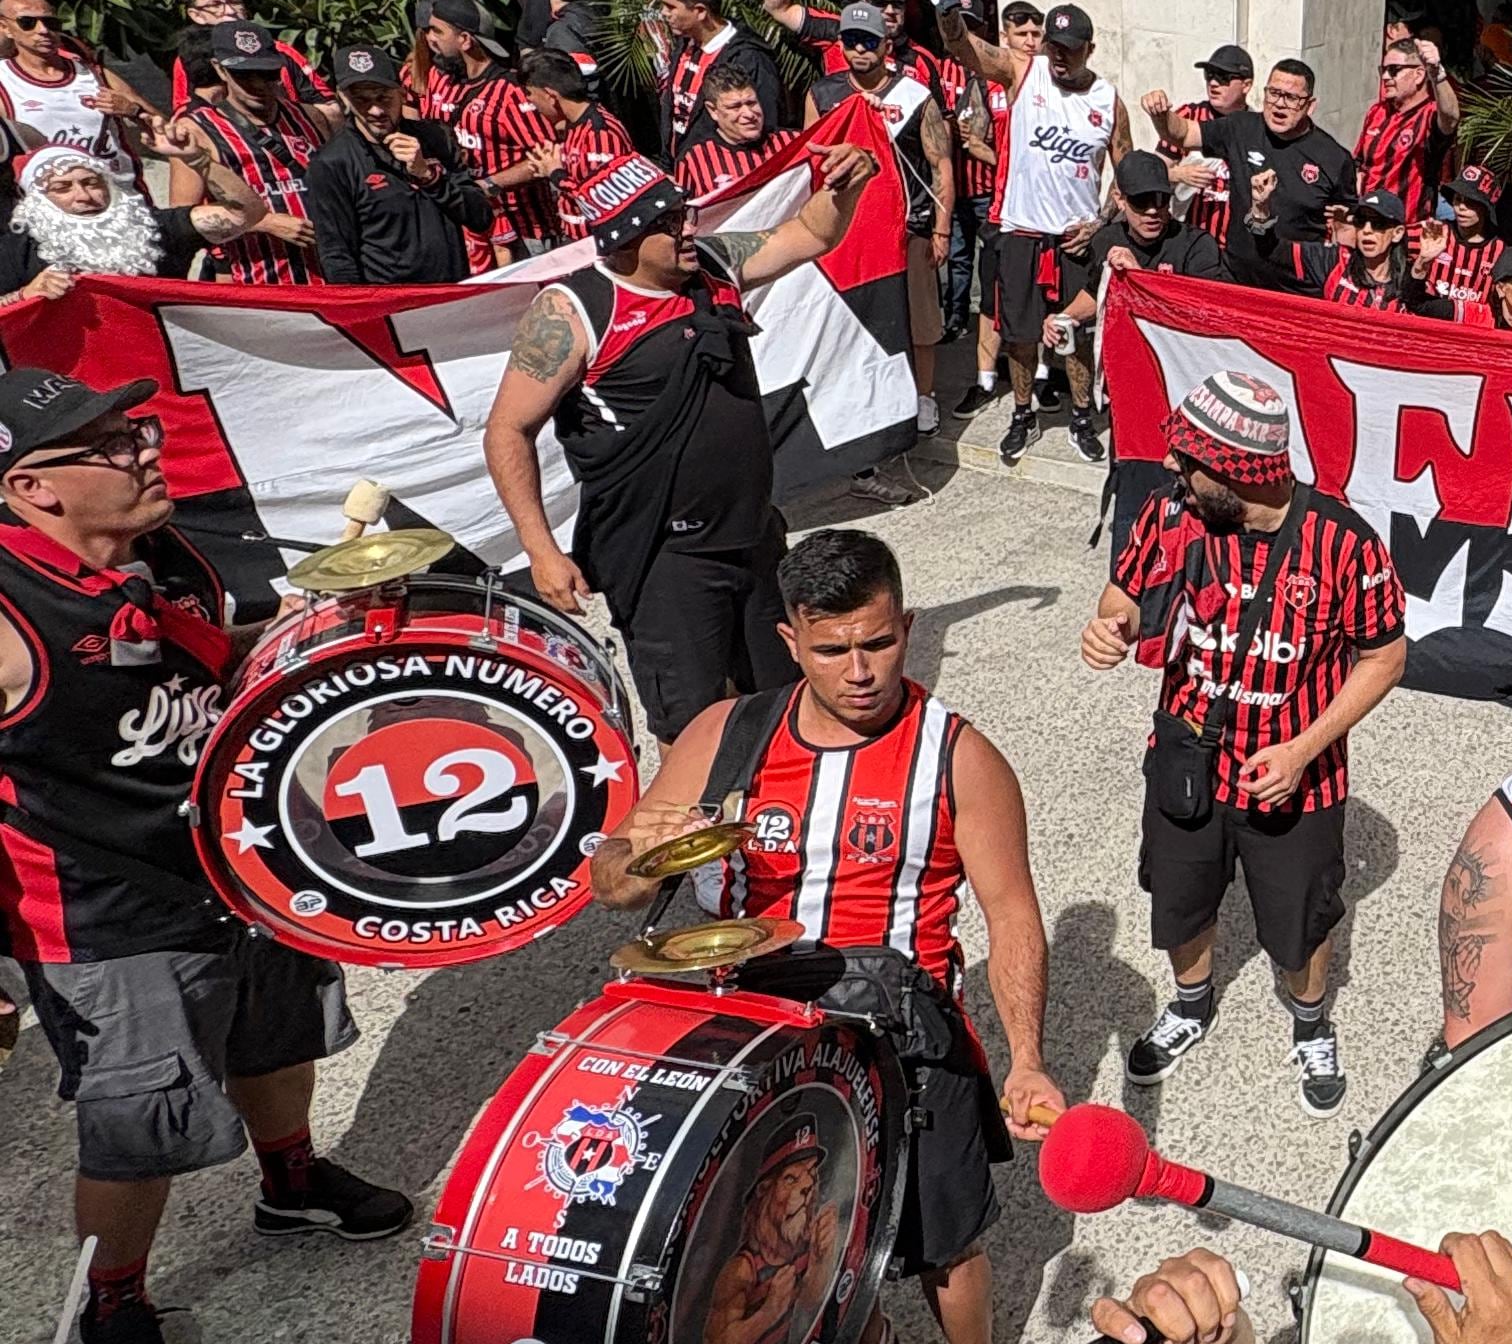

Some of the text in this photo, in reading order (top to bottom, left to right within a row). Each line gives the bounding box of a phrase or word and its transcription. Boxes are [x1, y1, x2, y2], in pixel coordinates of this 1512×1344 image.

[1028, 124, 1094, 164] Liga
[227, 654, 595, 799] LA GLORIOSA NUMERO
[335, 748, 529, 856] 12
[757, 814, 791, 840] 12
[354, 874, 580, 944] COSTA RICA
[577, 1056, 711, 1092] CON EL LEÓN
[619, 1084, 641, 1102] N
[810, 1042, 881, 1153] ALAJUELENSE
[794, 1125, 811, 1148] 12
[643, 1151, 662, 1171] E
[553, 1208, 568, 1230] S
[501, 1227, 602, 1265] A TODOS
[504, 1261, 580, 1295] LADOS
